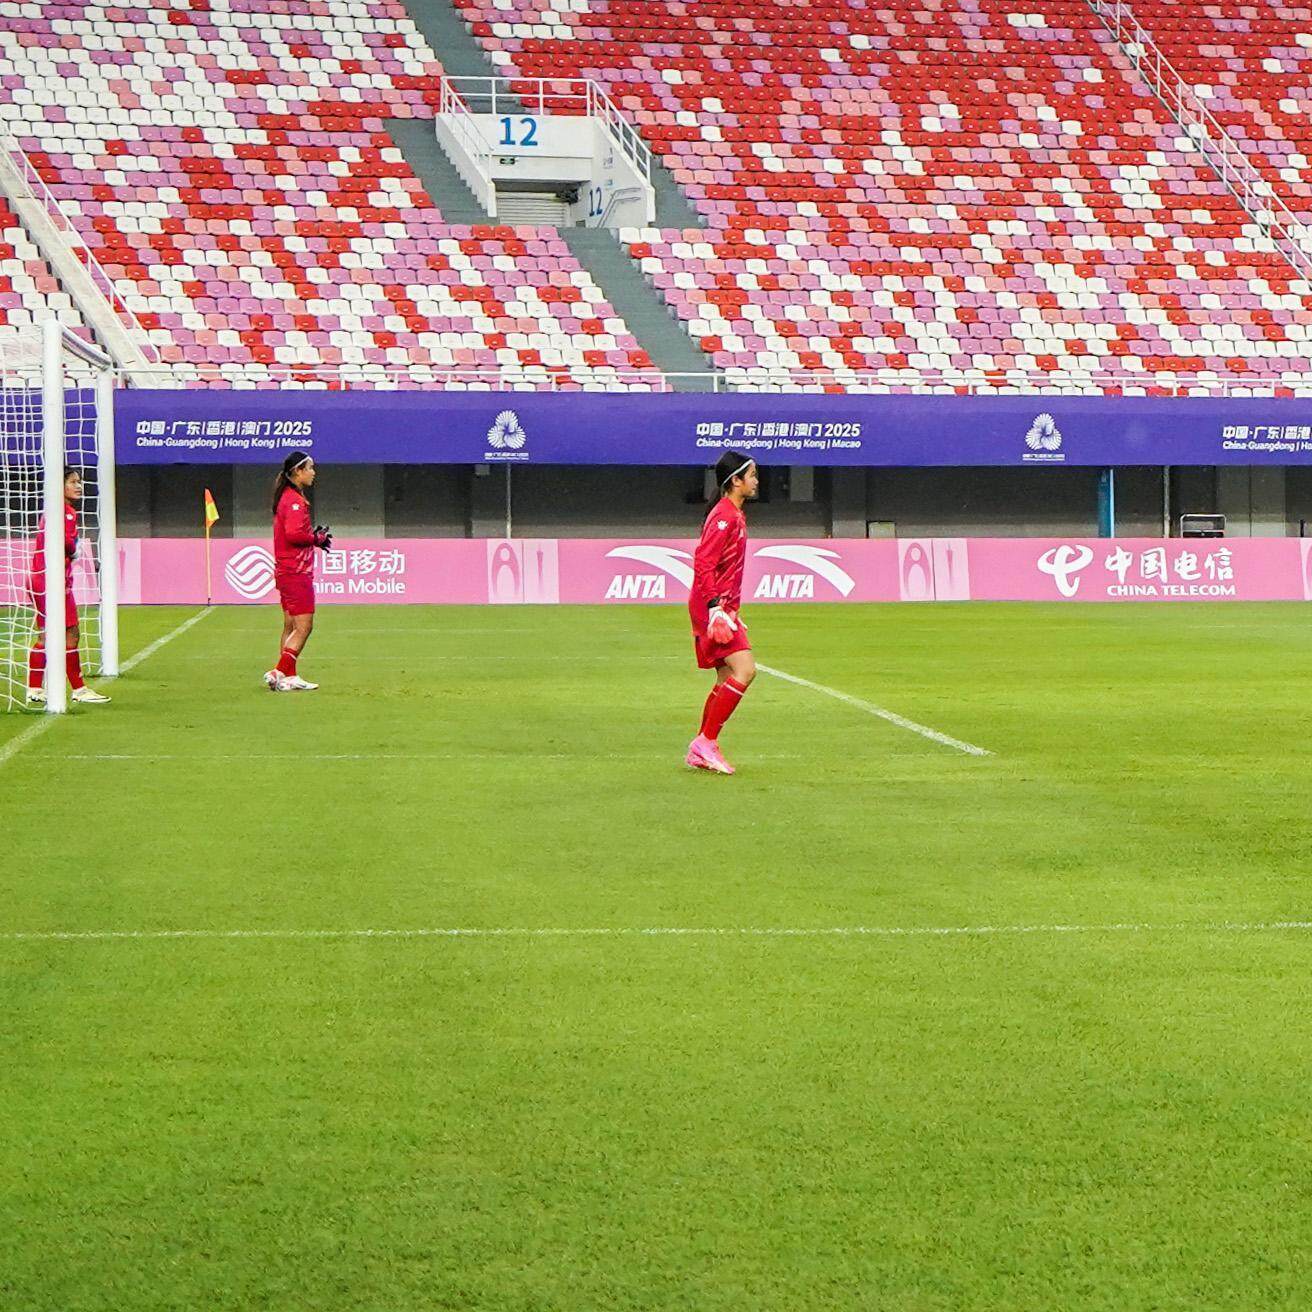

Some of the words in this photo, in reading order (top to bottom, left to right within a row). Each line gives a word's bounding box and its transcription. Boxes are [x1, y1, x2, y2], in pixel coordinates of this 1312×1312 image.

[499, 117, 538, 146] 12
[588, 187, 603, 217] 12
[273, 421, 312, 435] 2025
[825, 424, 861, 436] 2025
[224, 439, 249, 448] Hong
[251, 439, 275, 448] Kong
[778, 439, 802, 449] Hong
[803, 439, 826, 448] Kong
[831, 440, 861, 448] Macao
[313, 549, 405, 575] 国移动
[1104, 545, 1234, 584] 中国电信
[348, 578, 405, 594] Mobile
[605, 574, 666, 598] ANTA
[754, 574, 815, 598] ANTA
[1106, 585, 1157, 596] CHINA
[1161, 585, 1236, 596] TELECOM
